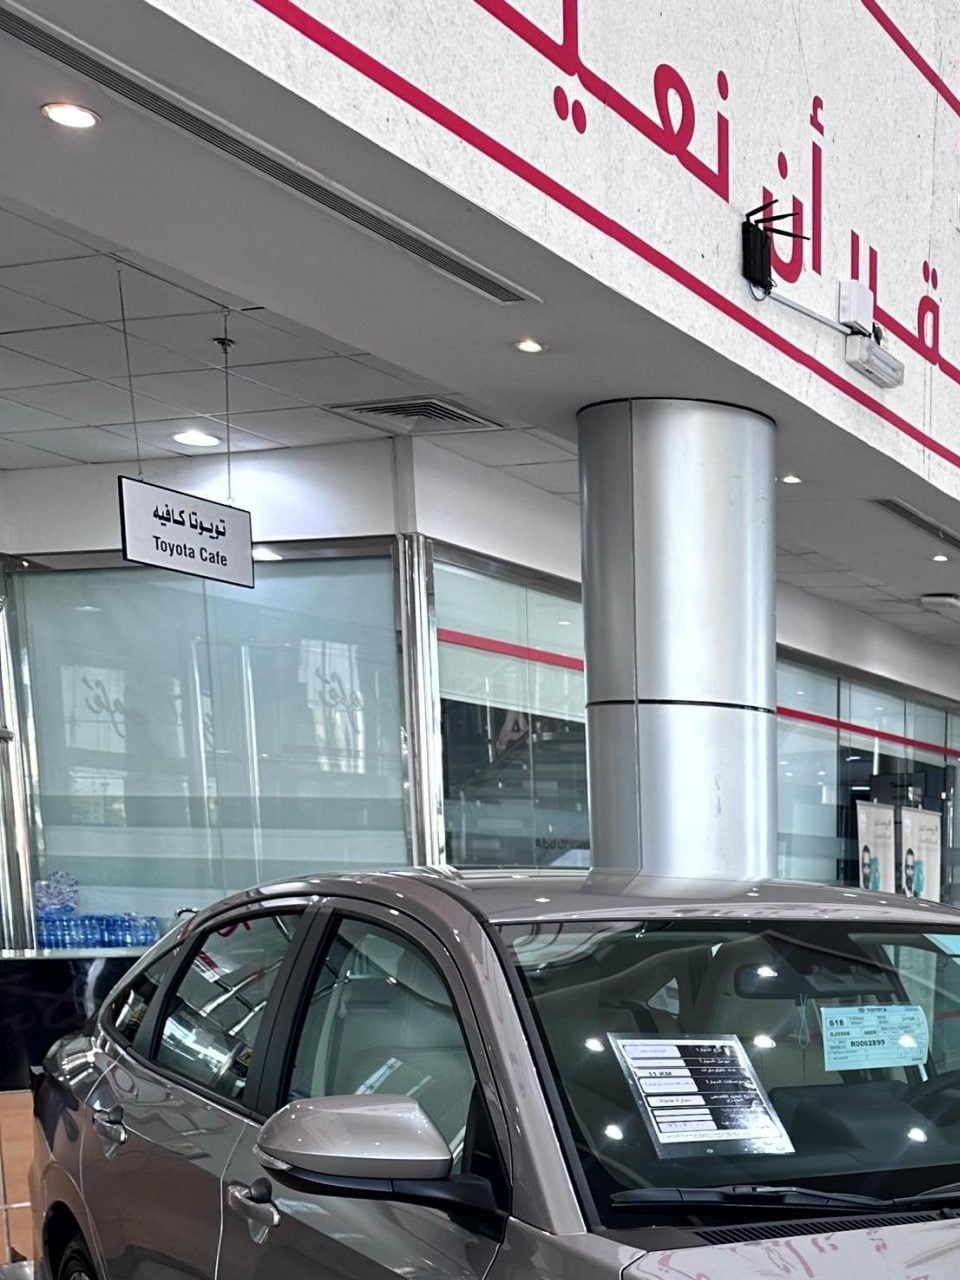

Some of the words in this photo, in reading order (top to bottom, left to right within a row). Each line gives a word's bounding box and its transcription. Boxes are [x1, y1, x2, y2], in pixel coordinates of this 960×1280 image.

[153, 503, 186, 527] كافيه
[188, 510, 226, 540] تويوتا
[152, 535, 195, 559] Toyota
[200, 547, 228, 567] Cafe
